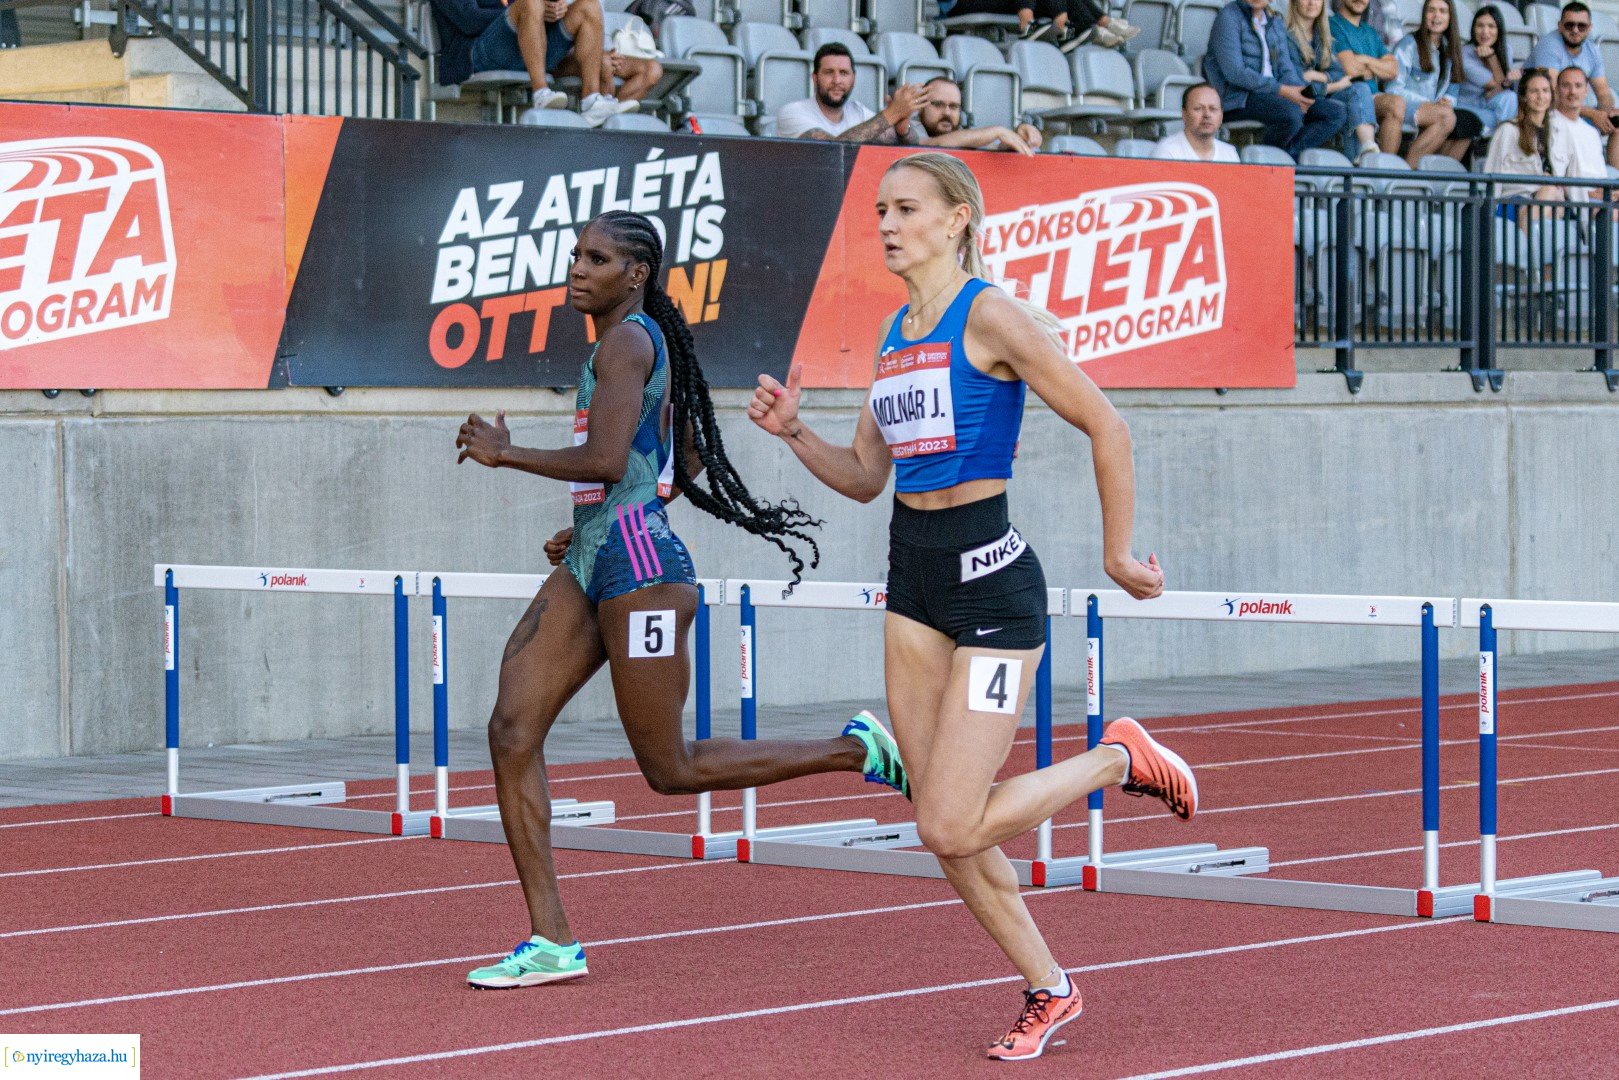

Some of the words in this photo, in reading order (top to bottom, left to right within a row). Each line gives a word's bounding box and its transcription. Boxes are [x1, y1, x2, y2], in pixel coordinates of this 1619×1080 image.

[438, 180, 524, 244] AZ
[529, 147, 725, 231] ATLÉTA
[676, 204, 727, 263] IS
[974, 200, 1112, 256] LYÖKBŐL
[986, 214, 1222, 319] TLÉTA
[428, 286, 568, 369] OTT
[1073, 291, 1221, 356] PROGRAM
[873, 384, 926, 427] MOLNÁR
[931, 387, 946, 418] J.
[918, 440, 949, 452] 2023
[583, 492, 602, 502] 2023
[972, 534, 1020, 572] NIKE
[270, 573, 308, 588] polanik
[1238, 599, 1293, 617] polanik
[644, 614, 664, 654] 5
[985, 662, 1008, 709] 4
[1087, 656, 1096, 696] polanik
[1480, 671, 1490, 714] polanik
